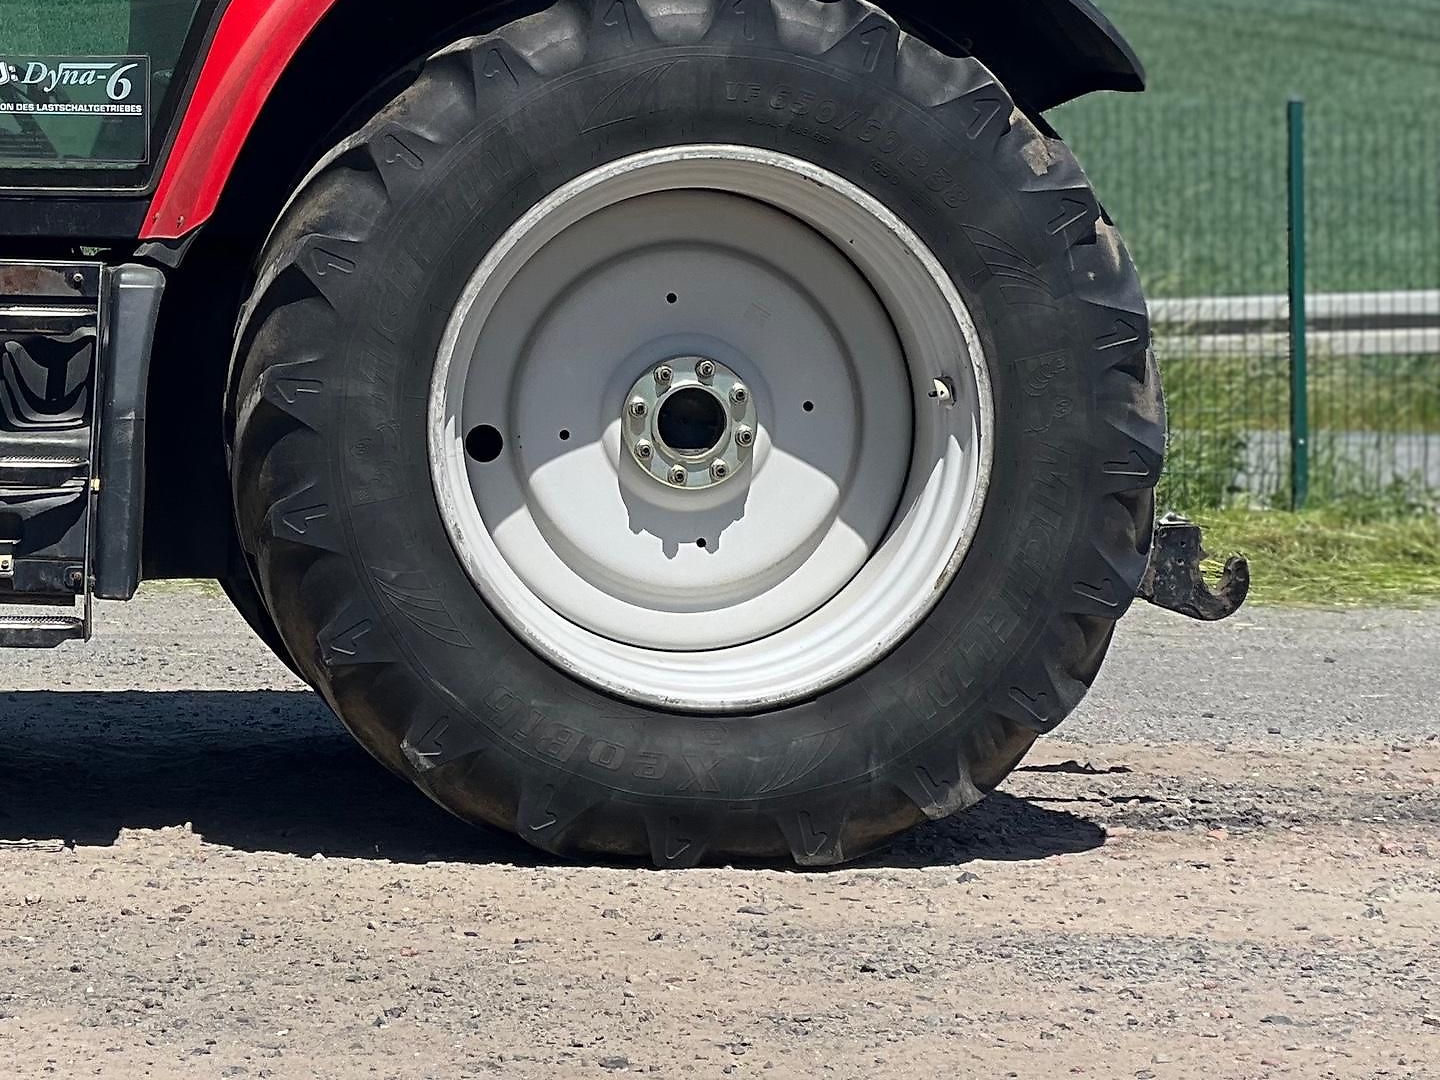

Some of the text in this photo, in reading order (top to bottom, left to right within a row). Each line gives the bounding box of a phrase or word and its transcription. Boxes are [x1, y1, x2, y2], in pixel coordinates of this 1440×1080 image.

[20, 62, 139, 101] Dyna-6
[16, 103, 35, 112] DES
[36, 103, 143, 113] LASTSCHALTGETRIEBES
